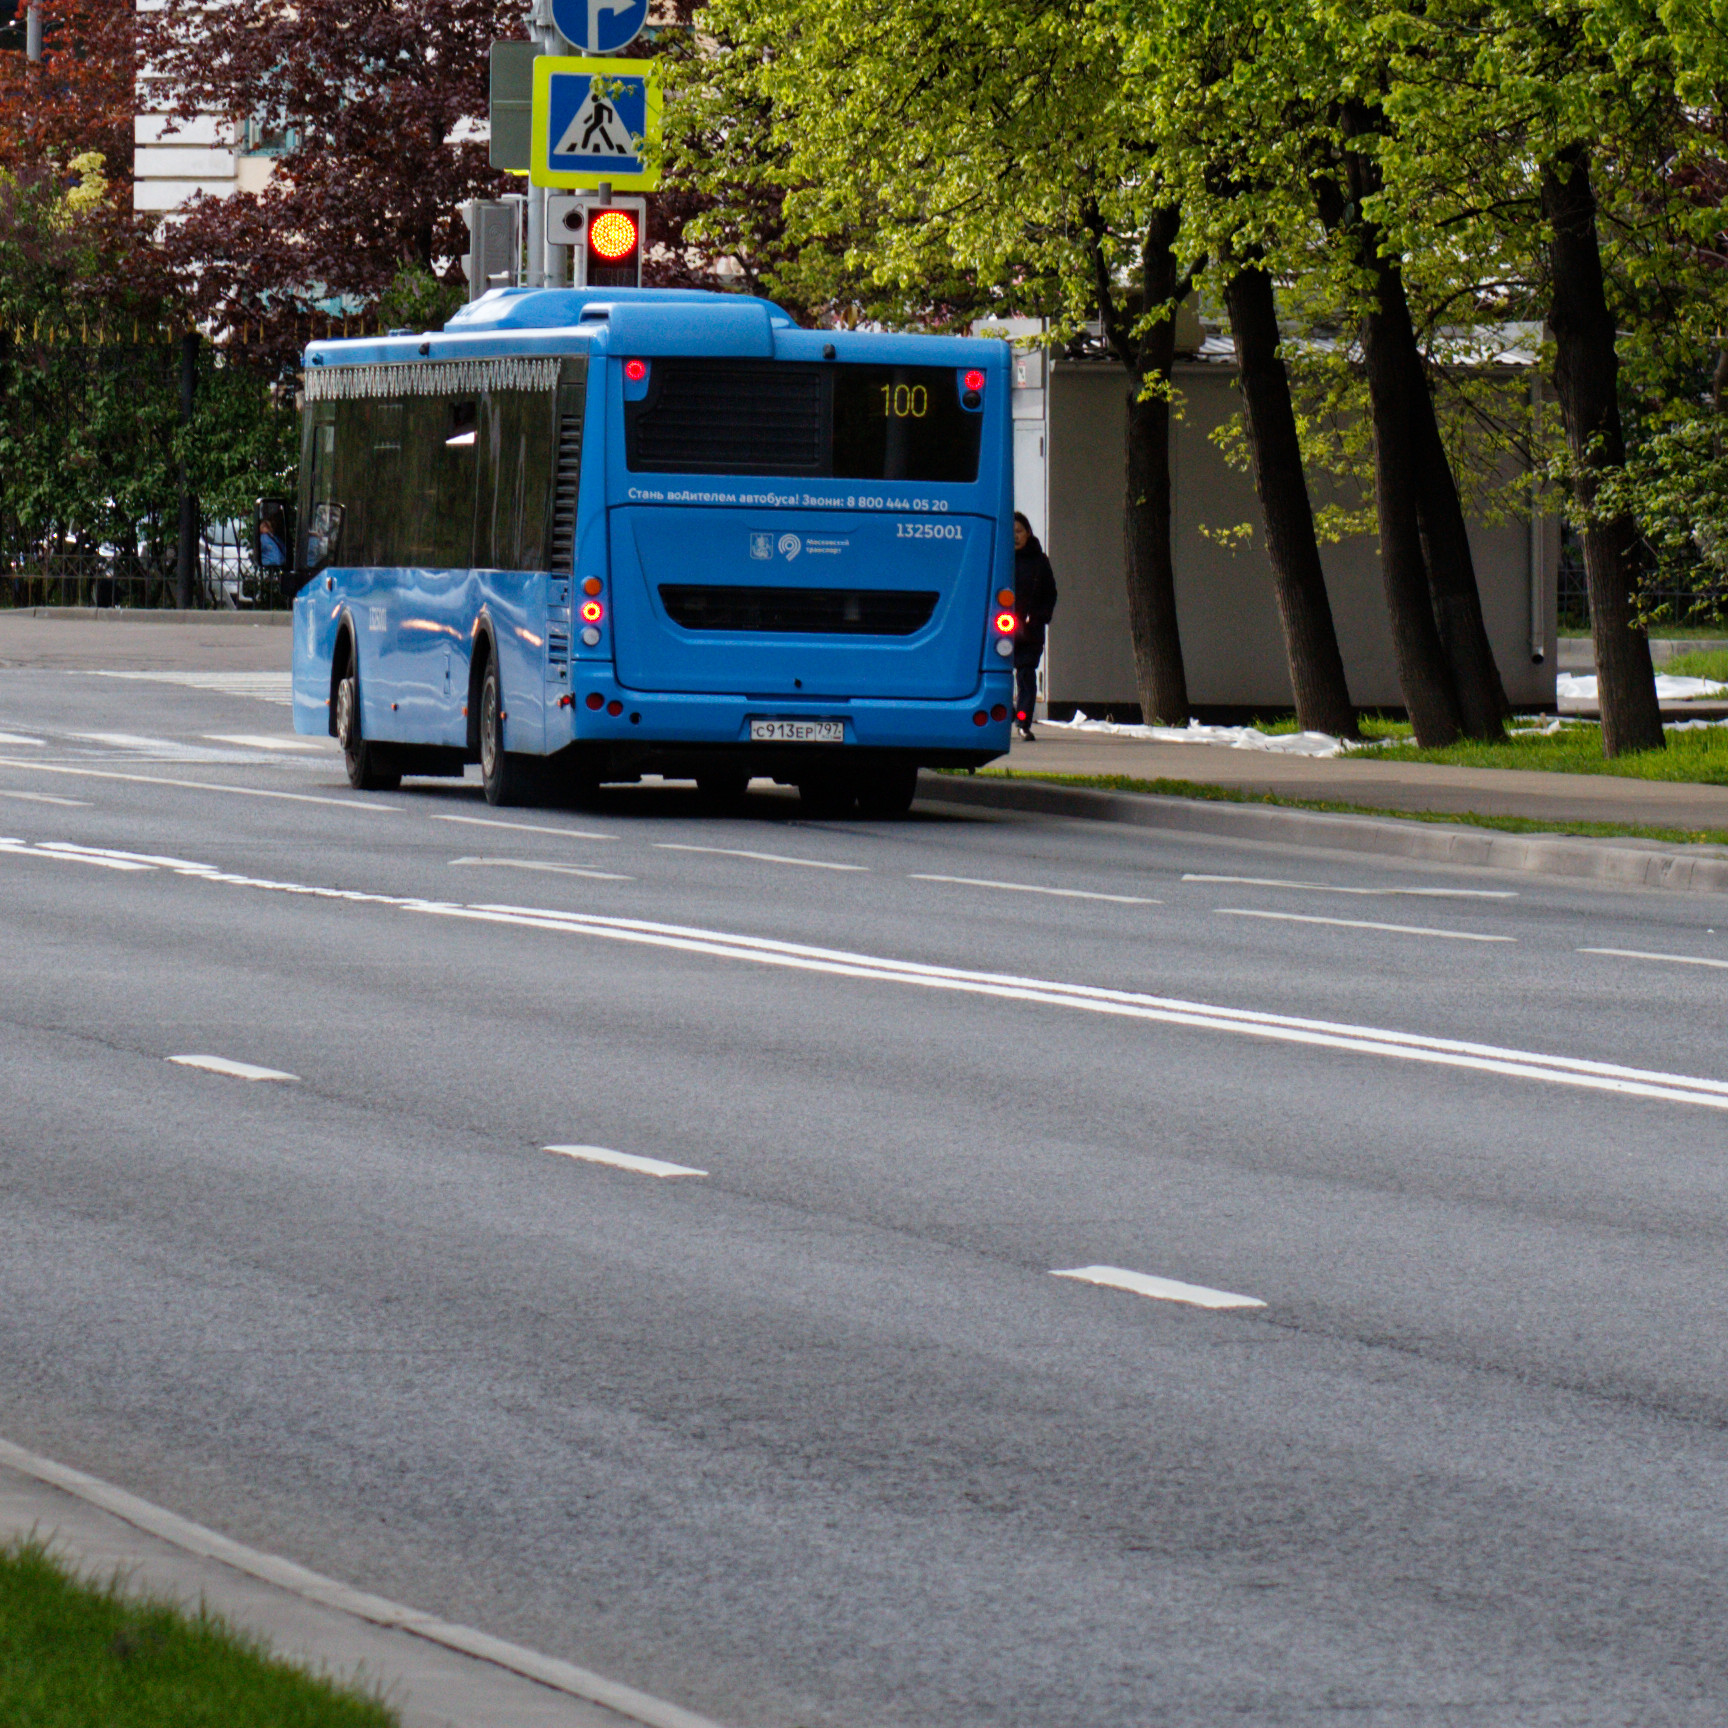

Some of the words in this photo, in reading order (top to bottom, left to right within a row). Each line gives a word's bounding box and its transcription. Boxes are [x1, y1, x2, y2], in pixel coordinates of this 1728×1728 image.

[880, 383, 928, 418] 100
[627, 487, 664, 500] Стань
[739, 492, 800, 507] автобуса!
[802, 494, 844, 507] Звони:
[847, 496, 855, 507] 8
[858, 497, 883, 509] 800
[886, 498, 910, 510] 444
[913, 499, 929, 511] 05
[931, 500, 948, 512] 20
[896, 523, 963, 540] 1325001
[756, 722, 814, 739] С913ЕР
[816, 723, 839, 735] 797
